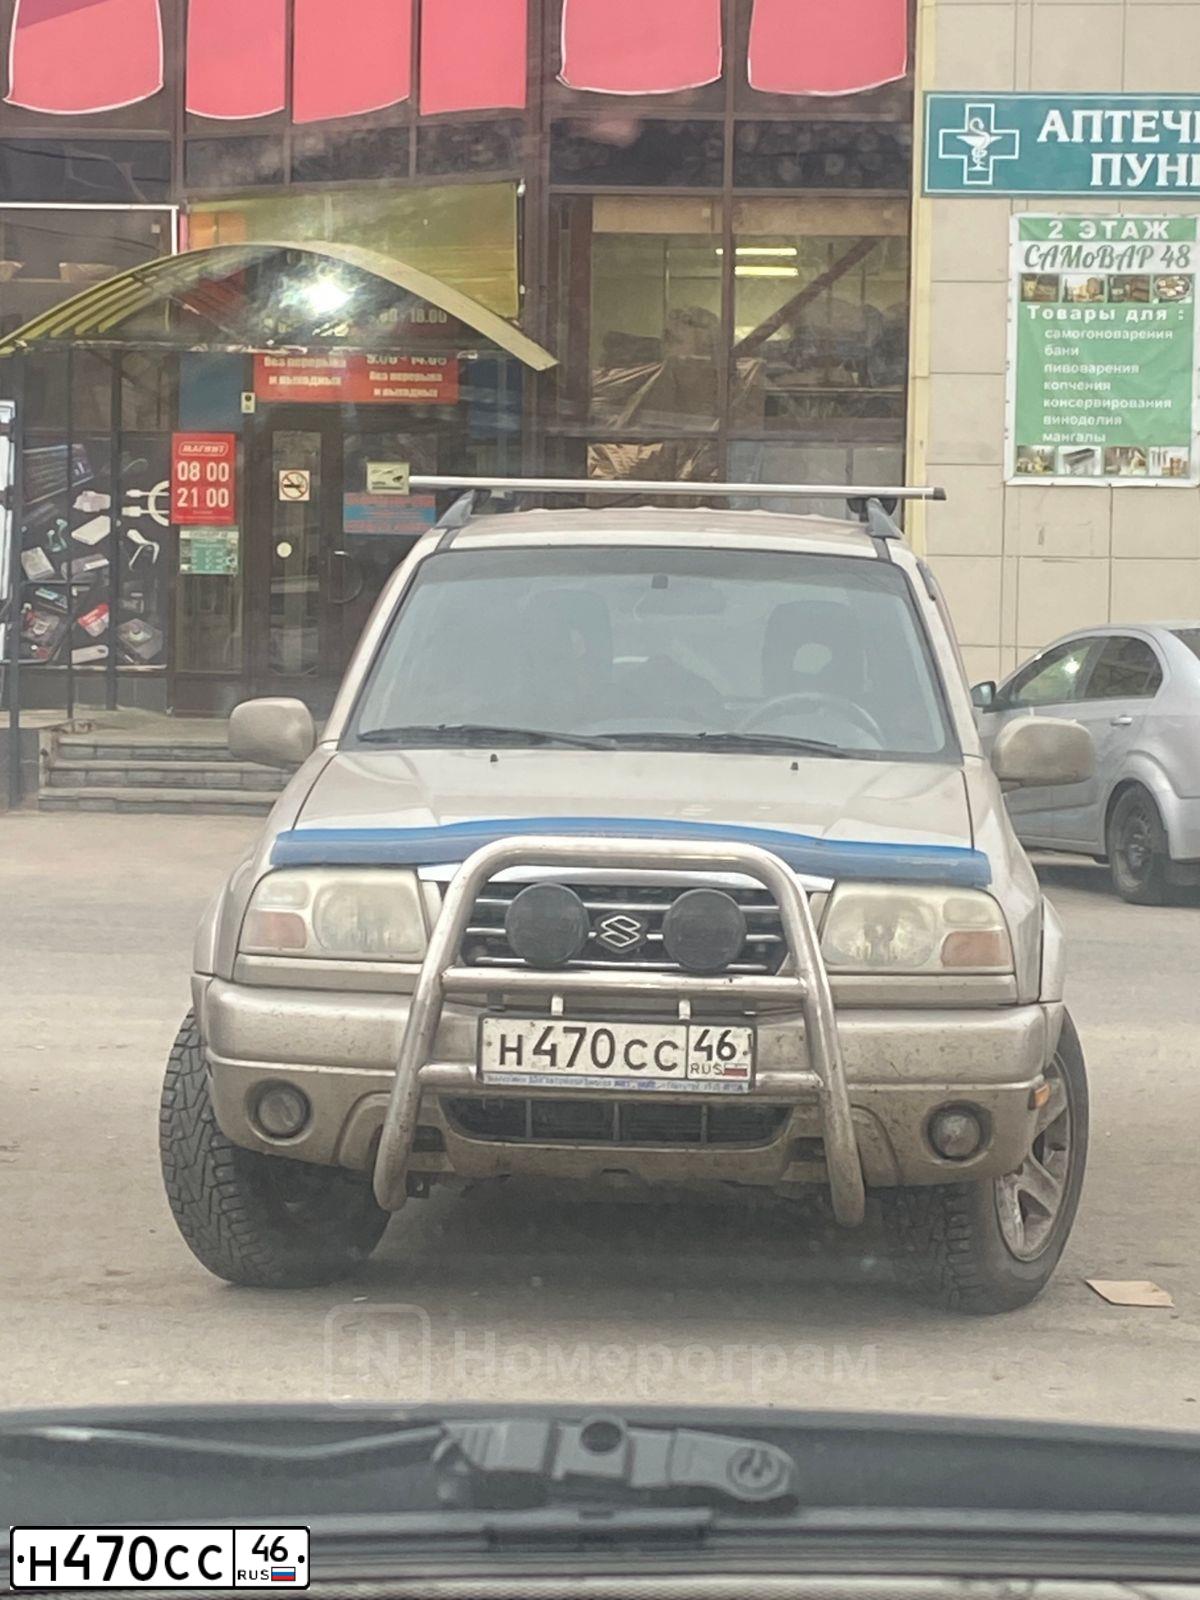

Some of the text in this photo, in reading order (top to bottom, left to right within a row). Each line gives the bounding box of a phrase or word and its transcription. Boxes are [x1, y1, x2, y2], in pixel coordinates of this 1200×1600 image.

[1037, 109, 1200, 144] АПТЕЧ
[1048, 220, 1170, 240] 2 ЭТАЖ
[1160, 243, 1192, 269] 48
[1027, 305, 1116, 323] Товары
[1125, 308, 1168, 323] для
[1044, 329, 1174, 342] самогоноварения
[1044, 343, 1080, 356] бани
[1043, 363, 1140, 376] пивоварения
[1043, 381, 1112, 391] копчения
[1043, 398, 1173, 409] консервирования
[1043, 414, 1123, 426] виноделия
[1042, 432, 1107, 442] мангалы
[177, 461, 229, 482] 08 00
[177, 487, 229, 508] 21 00
[693, 1029, 737, 1061] 46
[690, 1063, 723, 1075] RUS
